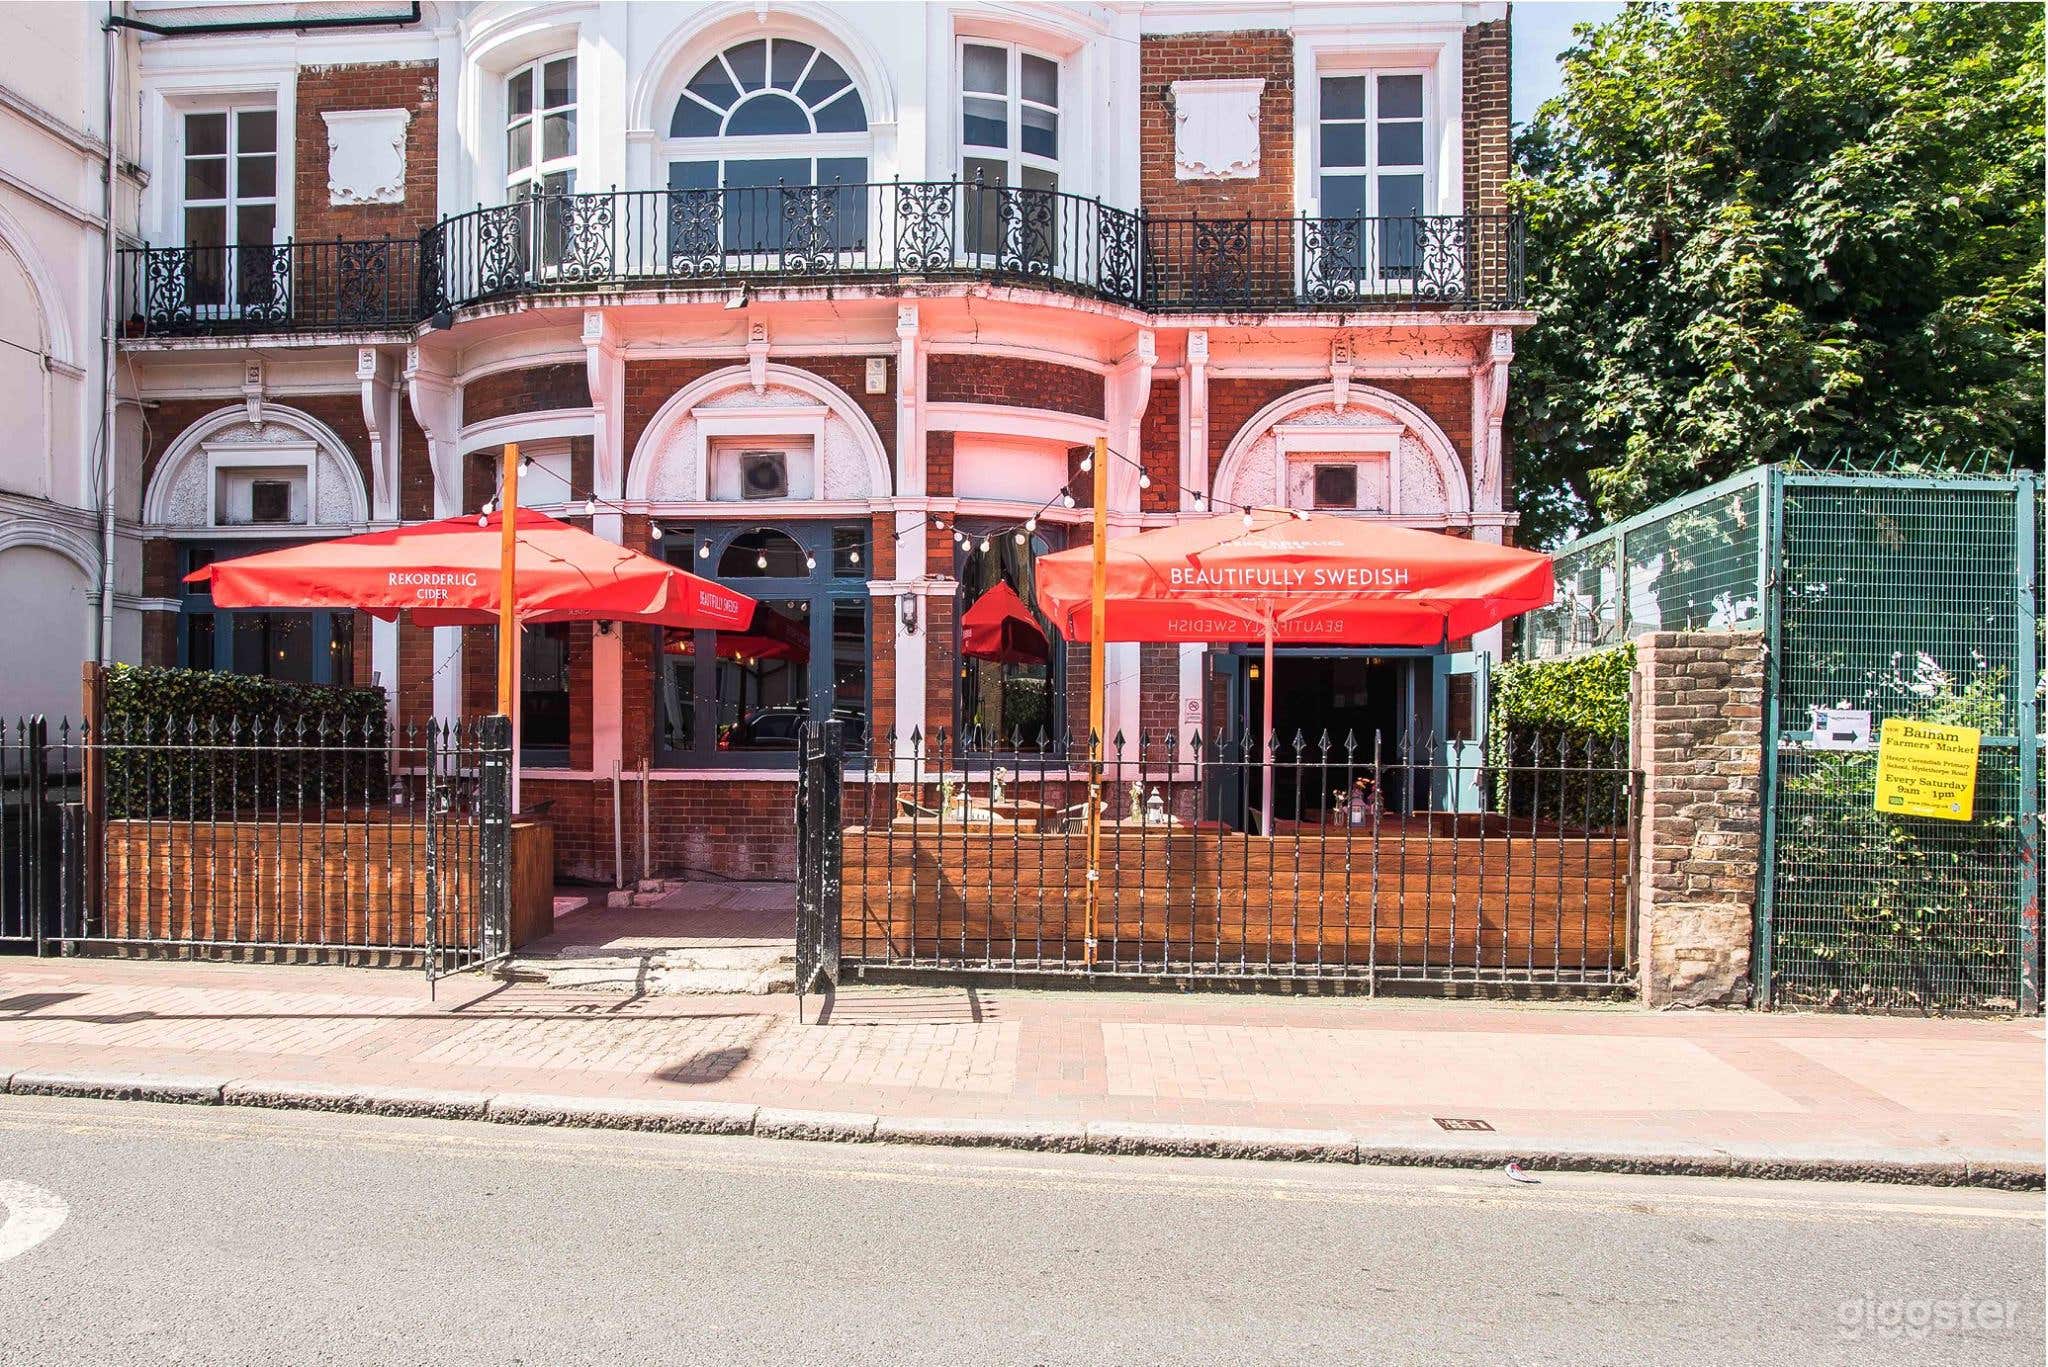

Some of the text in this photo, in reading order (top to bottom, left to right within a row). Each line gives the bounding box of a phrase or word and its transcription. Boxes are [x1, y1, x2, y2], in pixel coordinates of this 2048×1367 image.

[388, 572, 477, 587] REKORDERLIG
[1170, 567, 1409, 586] BEAUTIFULLY SWEDISH
[416, 588, 449, 600] CIDER
[1936, 742, 1975, 754] Market
[1886, 774, 1968, 792] Every Saturday
[1897, 785, 1920, 795] 9am
[1932, 790, 1955, 800] 1pm
